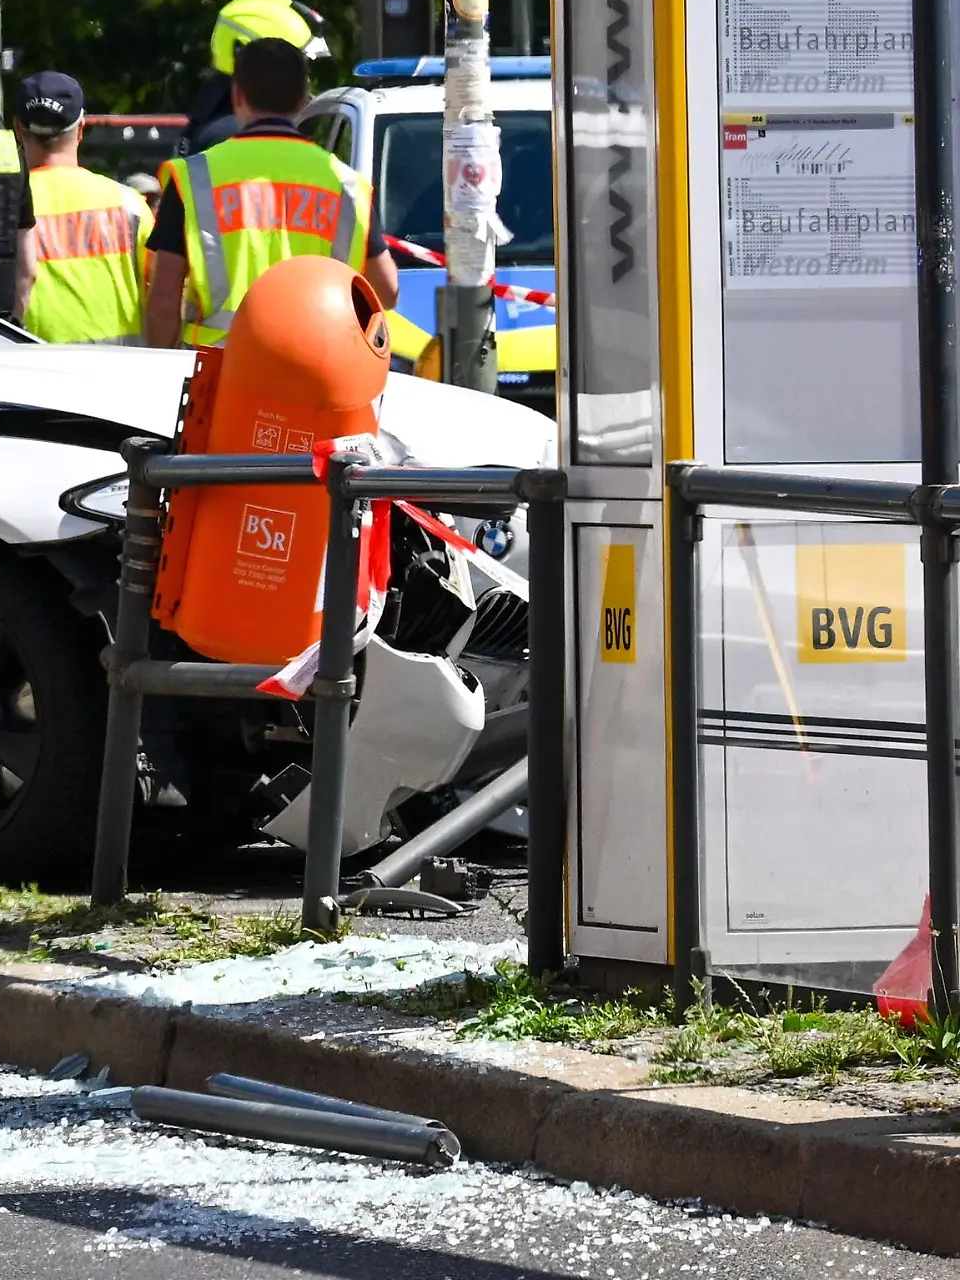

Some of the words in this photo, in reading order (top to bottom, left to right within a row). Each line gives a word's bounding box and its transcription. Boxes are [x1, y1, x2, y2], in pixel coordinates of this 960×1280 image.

[739, 25, 913, 57] Baufahrplan
[25, 97, 64, 112] POLIZEI
[724, 132, 746, 141] Tram
[220, 187, 337, 231] POLIZEI
[741, 207, 914, 239] Baufahrplan
[246, 514, 286, 552] BSR
[605, 607, 632, 651] BVG
[811, 605, 894, 651] BVG
